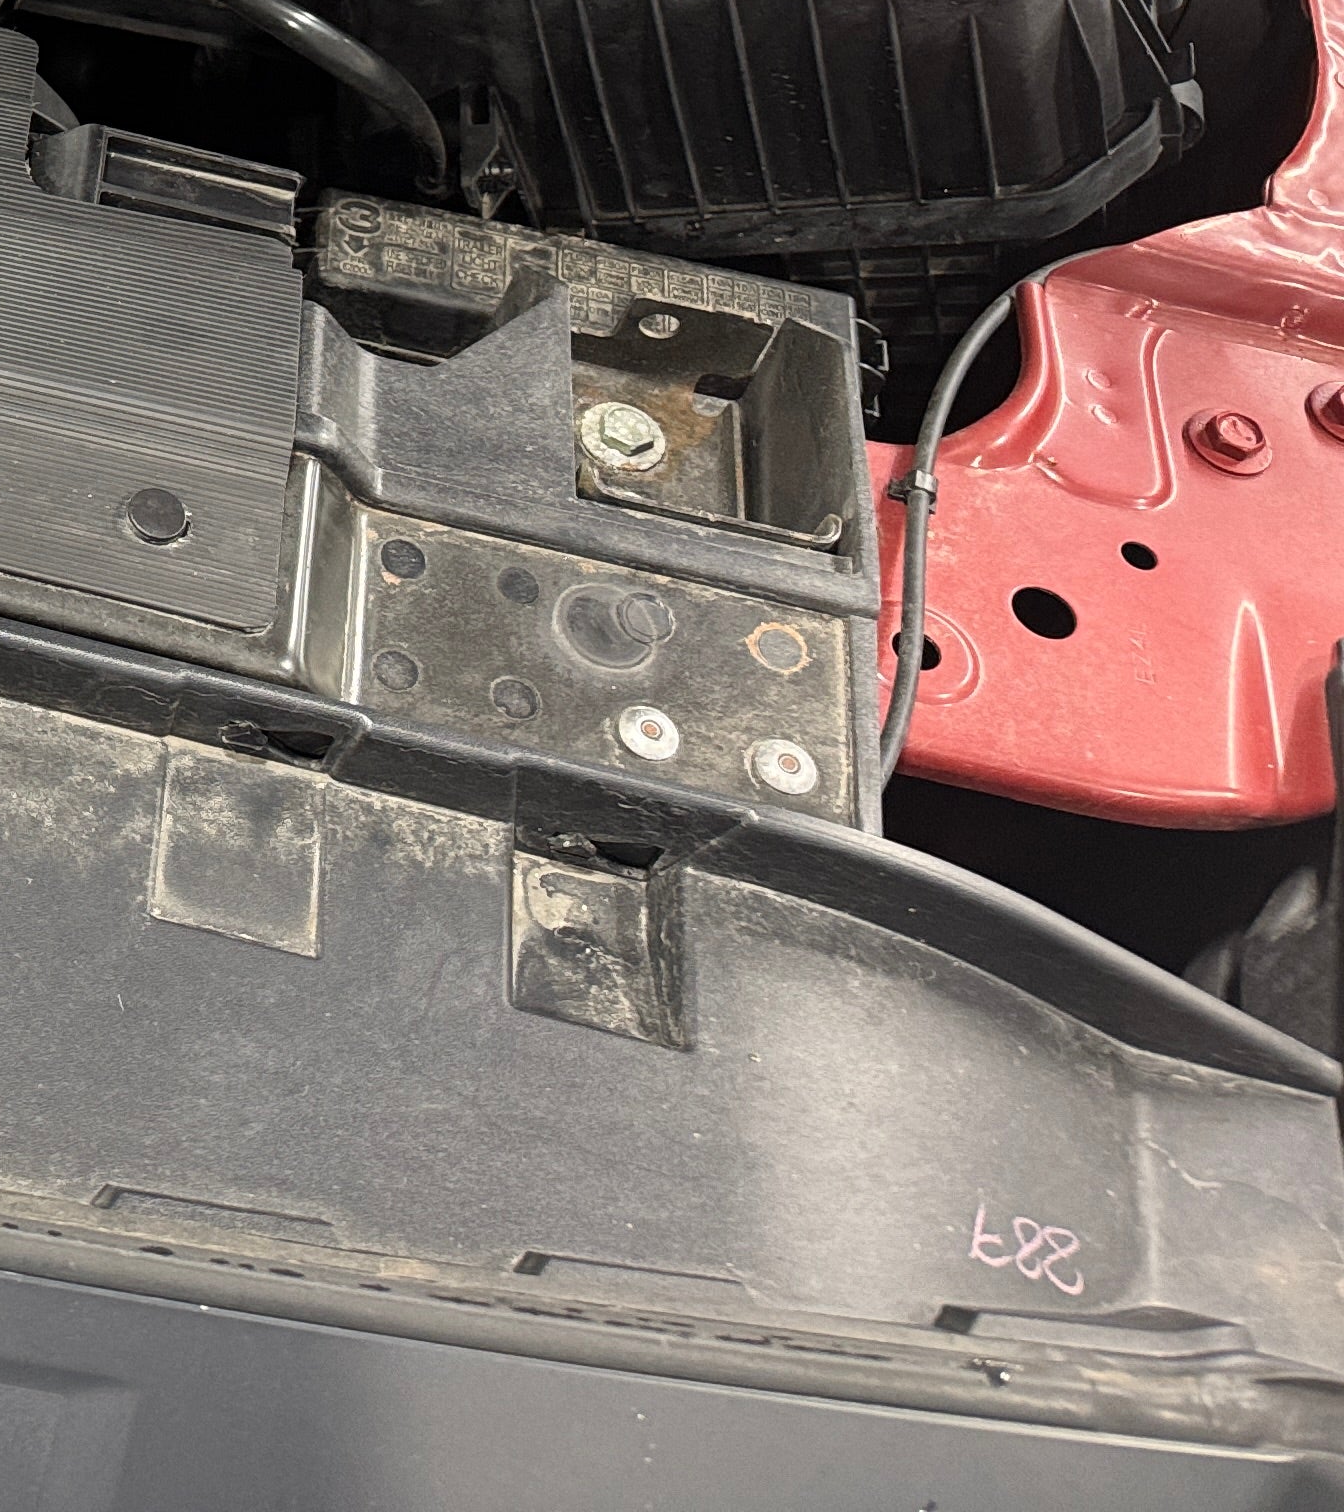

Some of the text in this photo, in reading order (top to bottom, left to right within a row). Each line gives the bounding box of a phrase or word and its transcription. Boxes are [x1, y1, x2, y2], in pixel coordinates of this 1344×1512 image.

[336, 198, 382, 236] 3
[455, 238, 503, 256] TRAILER
[462, 253, 499, 271] LIGHT
[456, 270, 500, 287] CHECK
